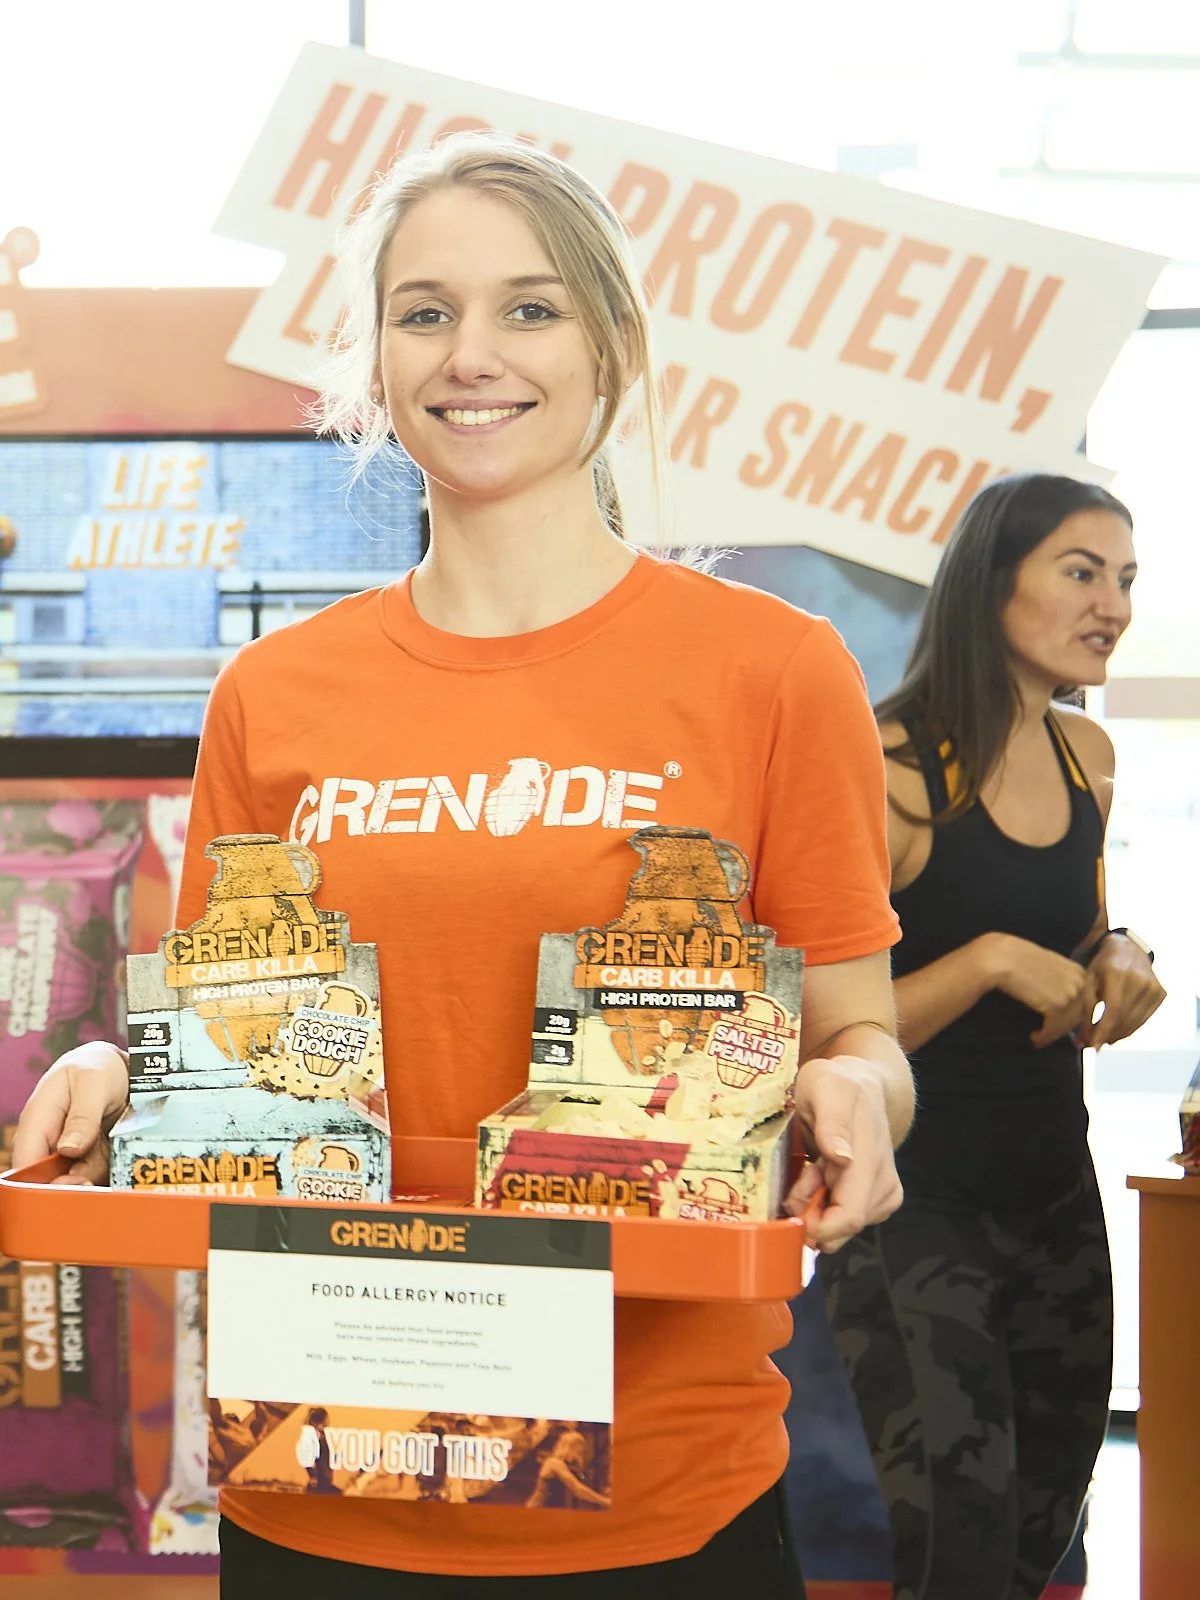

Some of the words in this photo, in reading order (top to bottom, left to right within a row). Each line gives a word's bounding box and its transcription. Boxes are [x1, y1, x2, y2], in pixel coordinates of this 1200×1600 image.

[105, 446, 210, 512] LIFE
[191, 960, 252, 983] CARB
[256, 956, 319, 977] KILLA
[600, 967, 664, 988] CARB
[668, 969, 737, 990] KILLA
[192, 984, 229, 1001] HIGH
[231, 980, 289, 998] PROTEIN
[290, 976, 321, 991] BAR
[600, 992, 638, 1006] HIGH
[640, 992, 702, 1007] PROTEIN
[703, 994, 736, 1008] BAR
[301, 1008, 350, 1026] CHOCOLATE
[350, 1016, 371, 1028] CHIP
[292, 1018, 369, 1049] COOKIE
[293, 1037, 362, 1065] DOUGH
[708, 1040, 781, 1073] PEANUT
[297, 1177, 362, 1200] COOKIE
[312, 1282, 356, 1299] FOOD
[361, 1286, 440, 1305] ALLERGY
[445, 1290, 508, 1308] NOTICE
[22, 1274, 57, 1371] CARB
[324, 1426, 381, 1472] YOU
[382, 1430, 440, 1477] GOT
[443, 1434, 512, 1482] THIS
